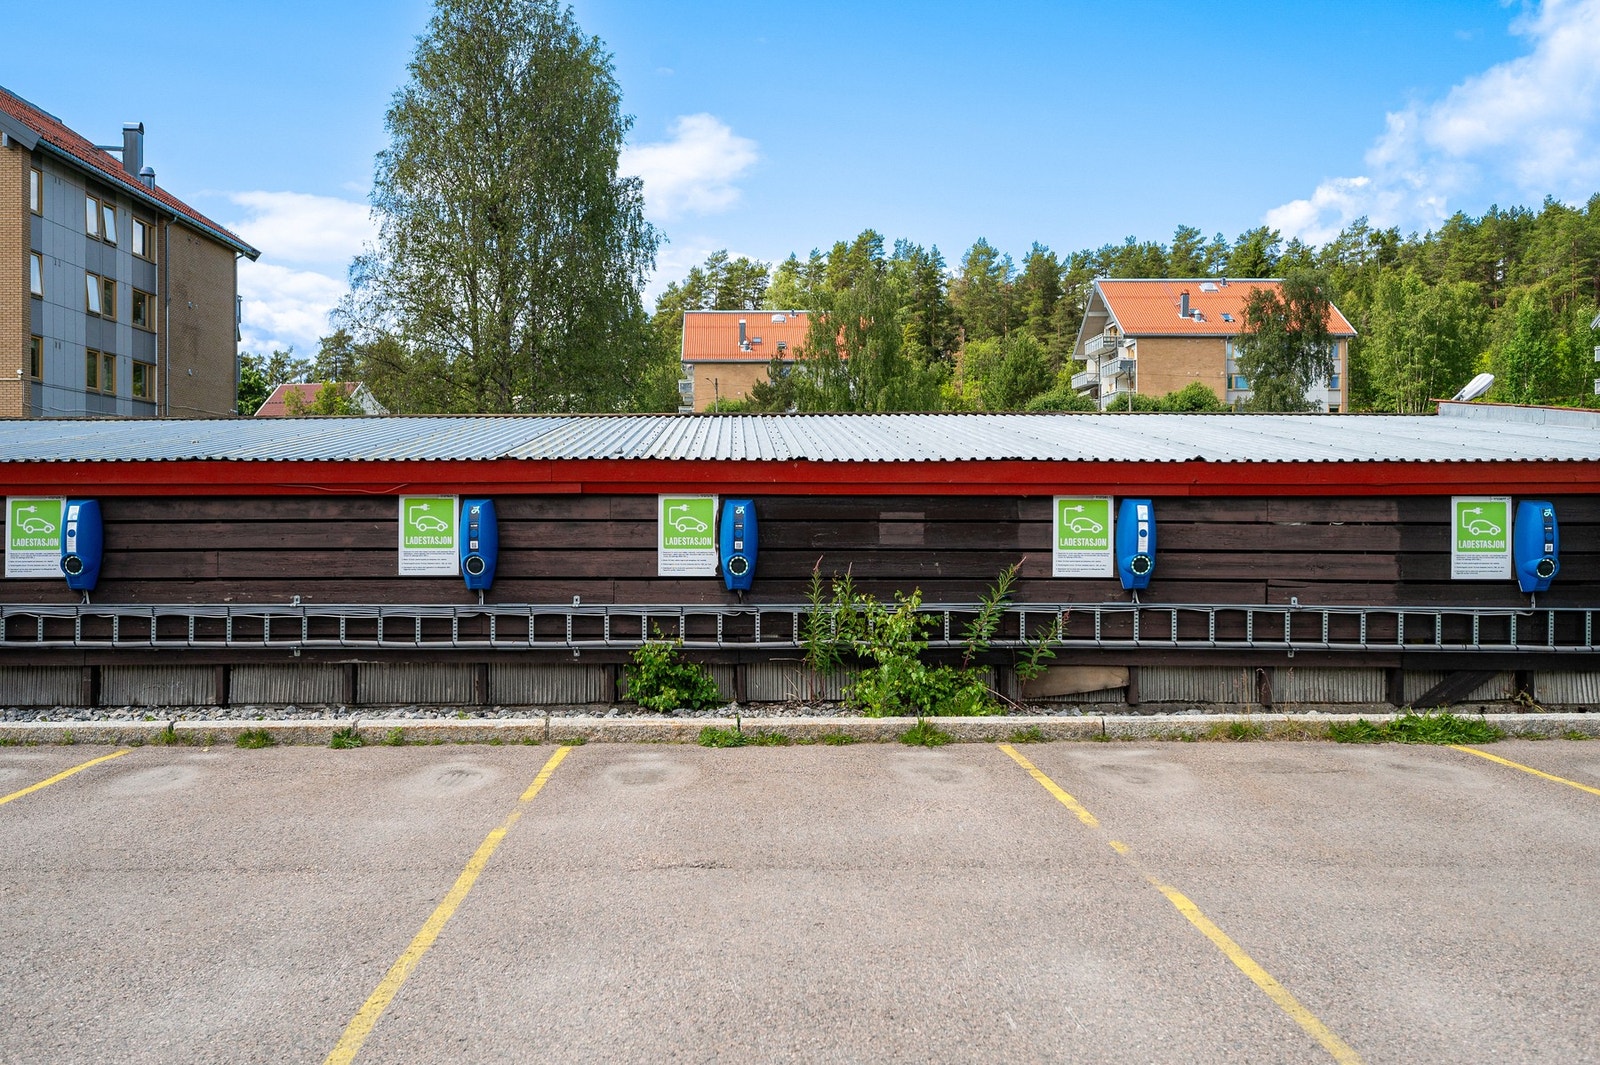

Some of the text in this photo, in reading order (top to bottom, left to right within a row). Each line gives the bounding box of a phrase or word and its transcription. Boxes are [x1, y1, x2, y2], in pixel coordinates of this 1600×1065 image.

[12, 538, 59, 546] LADESTASJON
[405, 536, 452, 545] LADESTASJON
[665, 537, 712, 546] LADESTASJON
[1060, 538, 1107, 547] LADESTASJON
[1458, 540, 1505, 549] LADESTASJON
